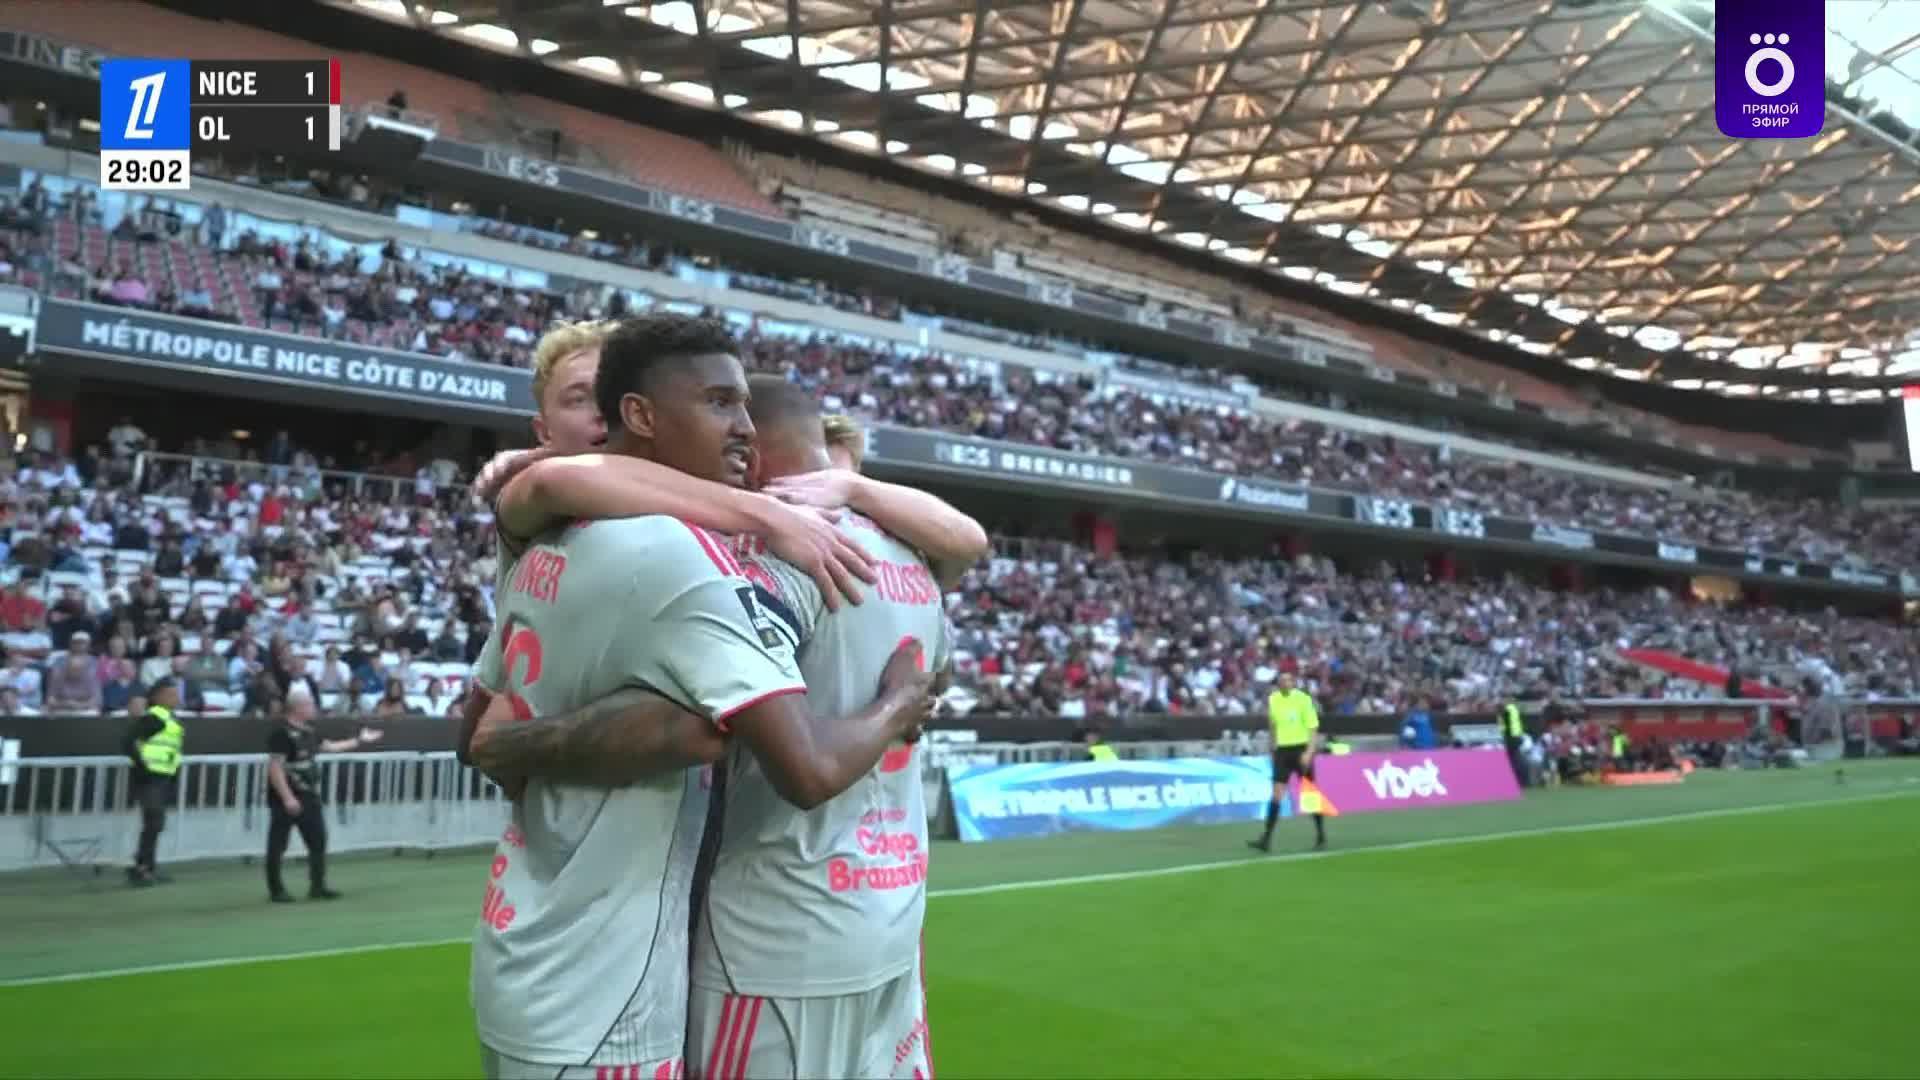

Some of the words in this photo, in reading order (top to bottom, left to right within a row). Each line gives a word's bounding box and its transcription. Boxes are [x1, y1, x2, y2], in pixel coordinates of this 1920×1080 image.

[482, 150, 560, 186] INEOS
[82, 318, 270, 368] MÉTROPOLE
[275, 348, 341, 378] NICE
[346, 356, 415, 389] CÔTE
[419, 370, 507, 401] D'AZUR
[1353, 496, 1413, 528] INEOS
[1431, 501, 1485, 538] INEOS
[1362, 757, 1448, 799] vbet
